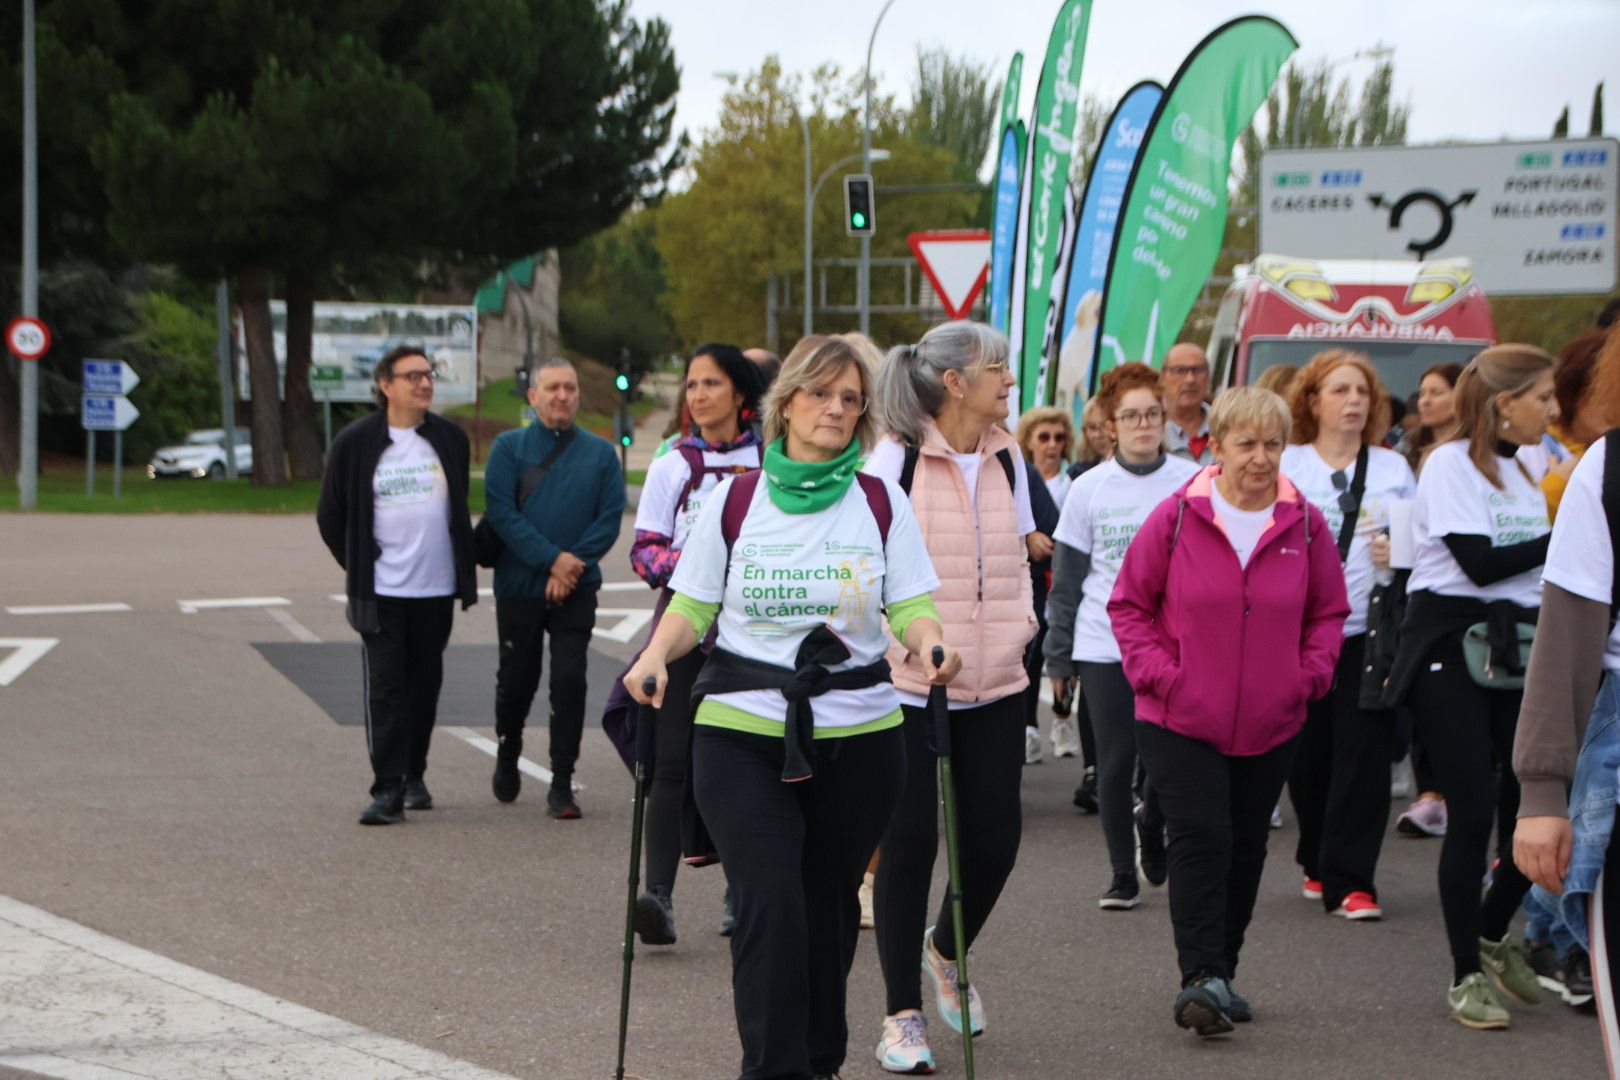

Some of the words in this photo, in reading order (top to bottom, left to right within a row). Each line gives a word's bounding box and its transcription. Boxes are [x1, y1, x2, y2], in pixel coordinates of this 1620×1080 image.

[1158, 160, 1217, 209] Tenemos
[1504, 174, 1604, 193] PORTUGAL
[1034, 151, 1058, 248] Corte
[1164, 194, 1199, 222] gran
[1492, 198, 1606, 218] VALLADOLID
[1523, 247, 1603, 265] ZAMORA
[376, 467, 392, 477] En
[395, 463, 438, 474] marcha
[379, 478, 416, 489] contra
[686, 499, 701, 510] En
[1497, 513, 1512, 527] En
[1102, 524, 1117, 536] En
[743, 564, 765, 580] En
[771, 565, 852, 580] marcha
[742, 584, 808, 600] contra
[744, 603, 762, 617] el
[765, 603, 838, 618] cáncer
